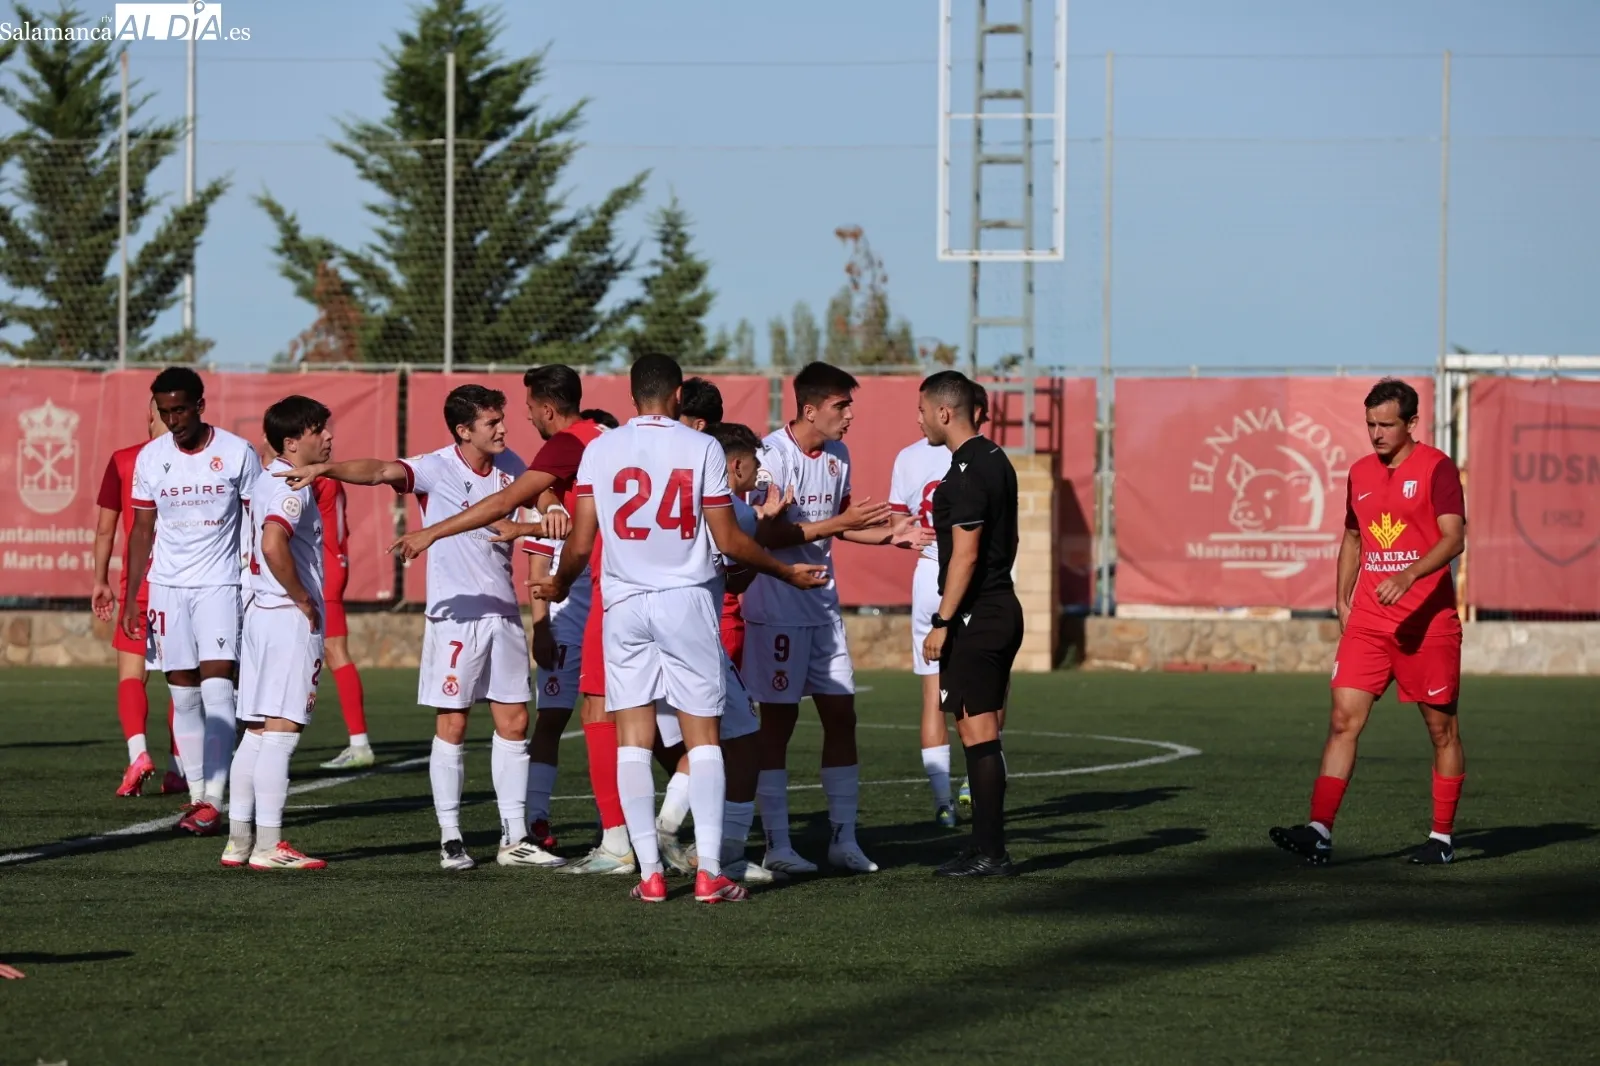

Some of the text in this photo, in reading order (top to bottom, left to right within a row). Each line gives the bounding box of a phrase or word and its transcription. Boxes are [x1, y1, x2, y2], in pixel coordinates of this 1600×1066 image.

[160, 484, 226, 498] ASPIRE
[613, 467, 697, 540] 24
[790, 493, 834, 506] ASPIR
[3, 551, 54, 570] Marta
[57, 551, 79, 570] de
[1382, 549, 1420, 562] RURAL
[149, 609, 166, 636] 21
[448, 640, 464, 669] 7
[774, 634, 790, 662] 9
[311, 658, 322, 686] 2
